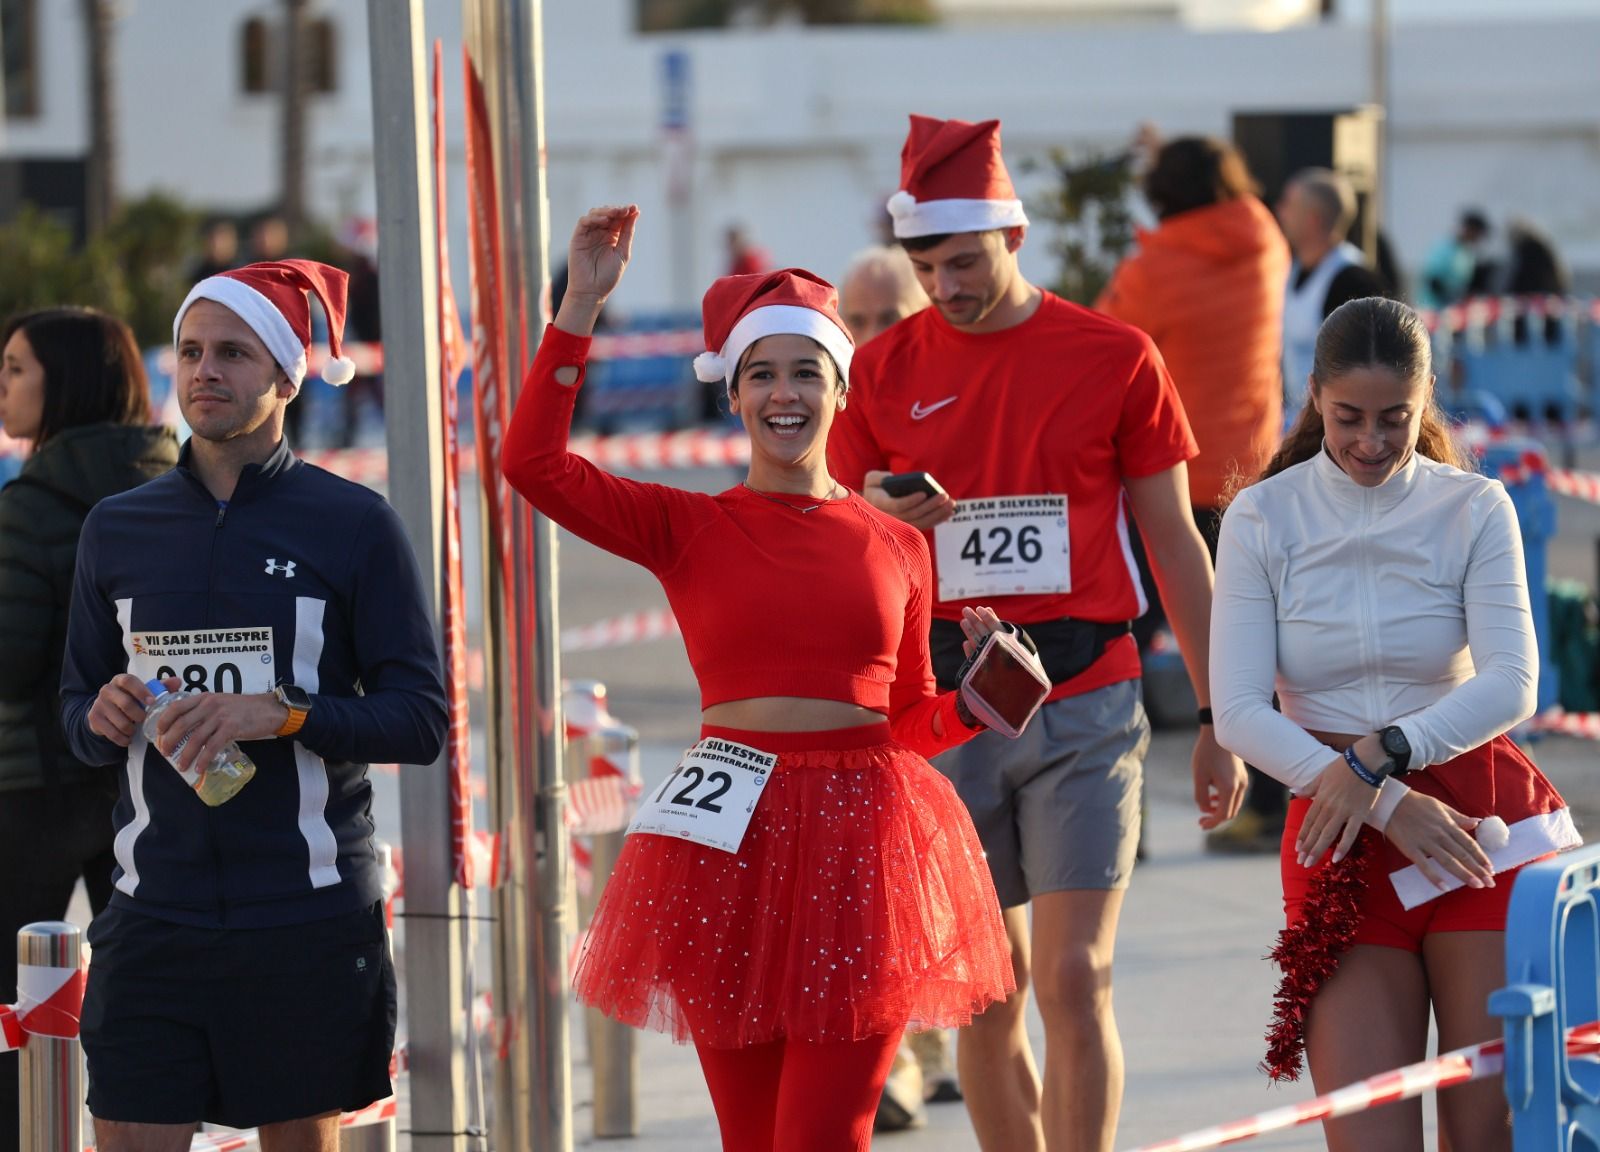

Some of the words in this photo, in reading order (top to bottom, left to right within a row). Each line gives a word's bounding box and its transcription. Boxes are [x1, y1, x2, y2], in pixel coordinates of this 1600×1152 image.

[970, 502, 995, 511] SAN
[1000, 498, 1065, 509] SILVESTRE
[960, 525, 1043, 566] 426
[145, 635, 159, 646] VII
[163, 634, 190, 646] SAN
[194, 632, 269, 644] SILVESTRE
[149, 648, 166, 657] REAL
[167, 647, 191, 656] CLUB
[707, 741, 773, 766] SILVESTRE
